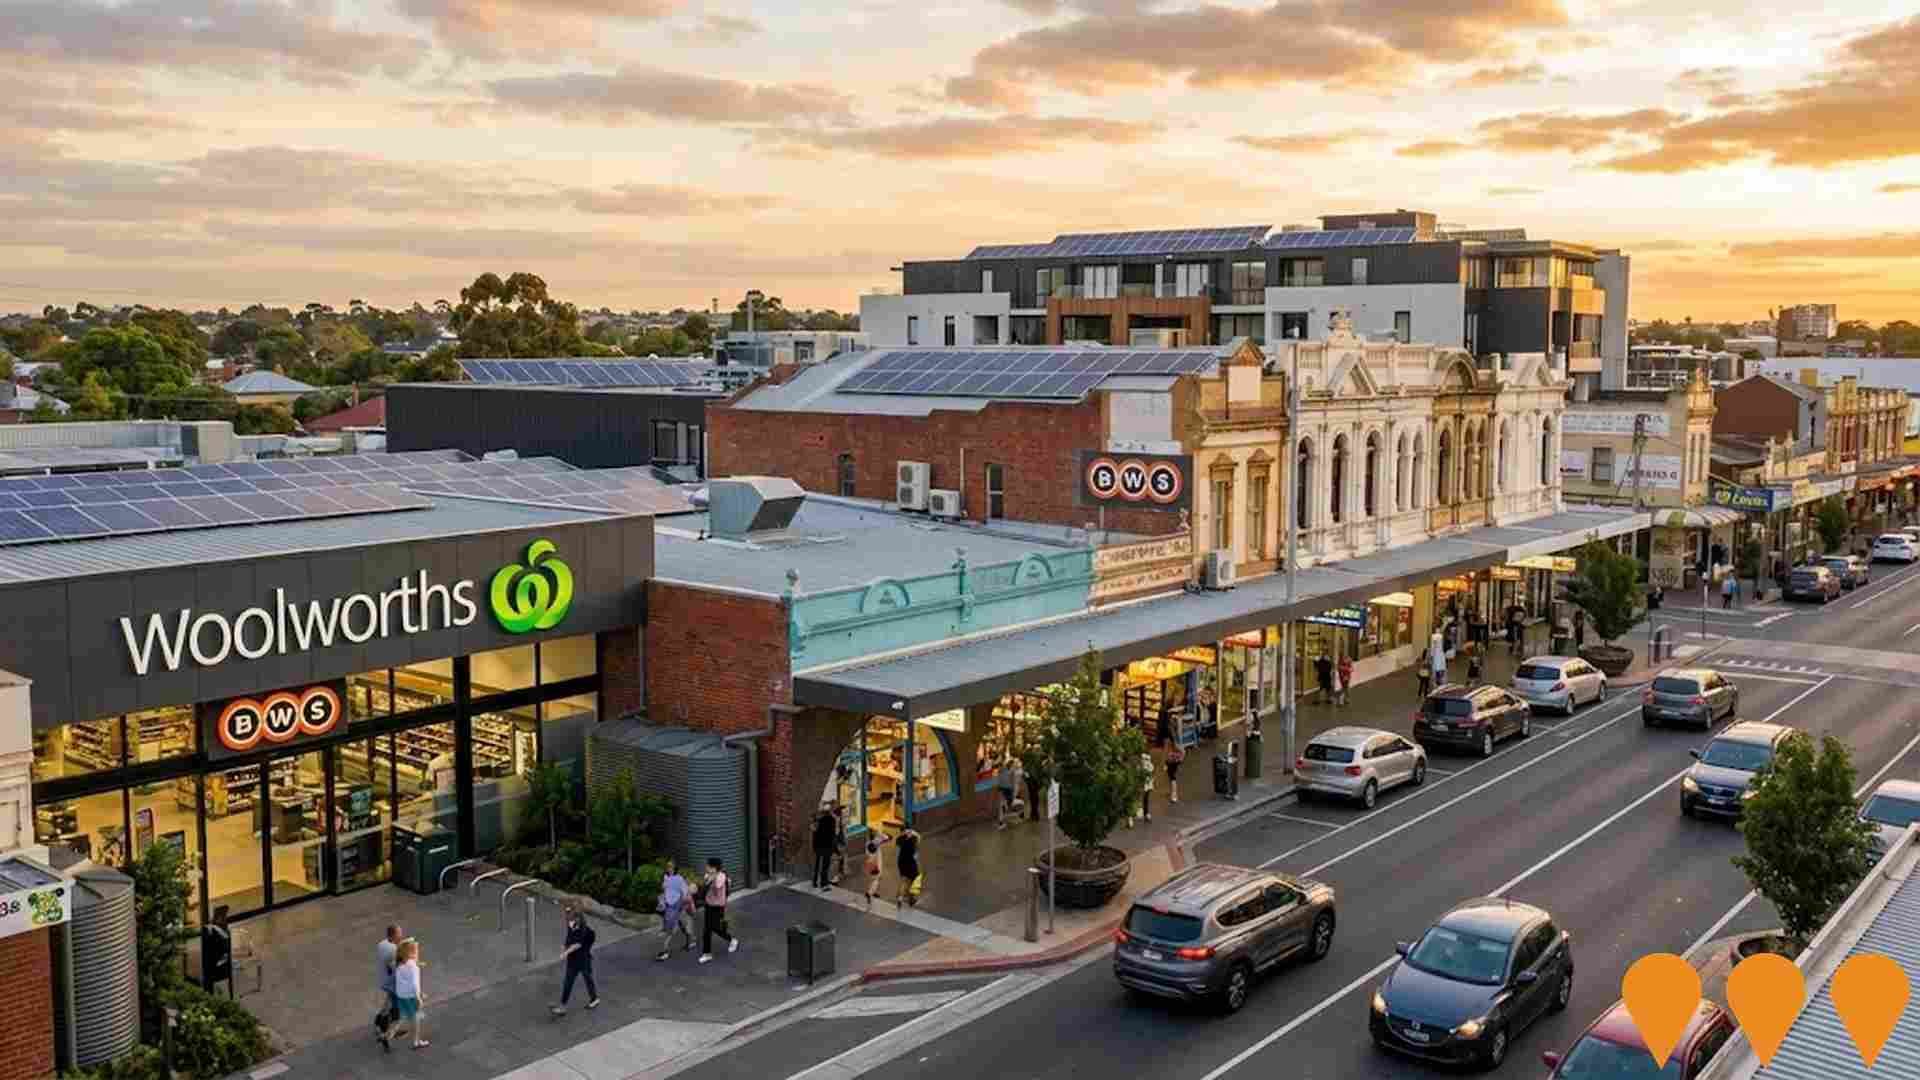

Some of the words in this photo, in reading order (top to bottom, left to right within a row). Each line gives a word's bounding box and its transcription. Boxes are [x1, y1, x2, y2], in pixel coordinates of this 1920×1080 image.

[1098, 469, 1170, 491] BWS
[119, 569, 478, 676] Woolworths
[233, 700, 326, 736] BWS
